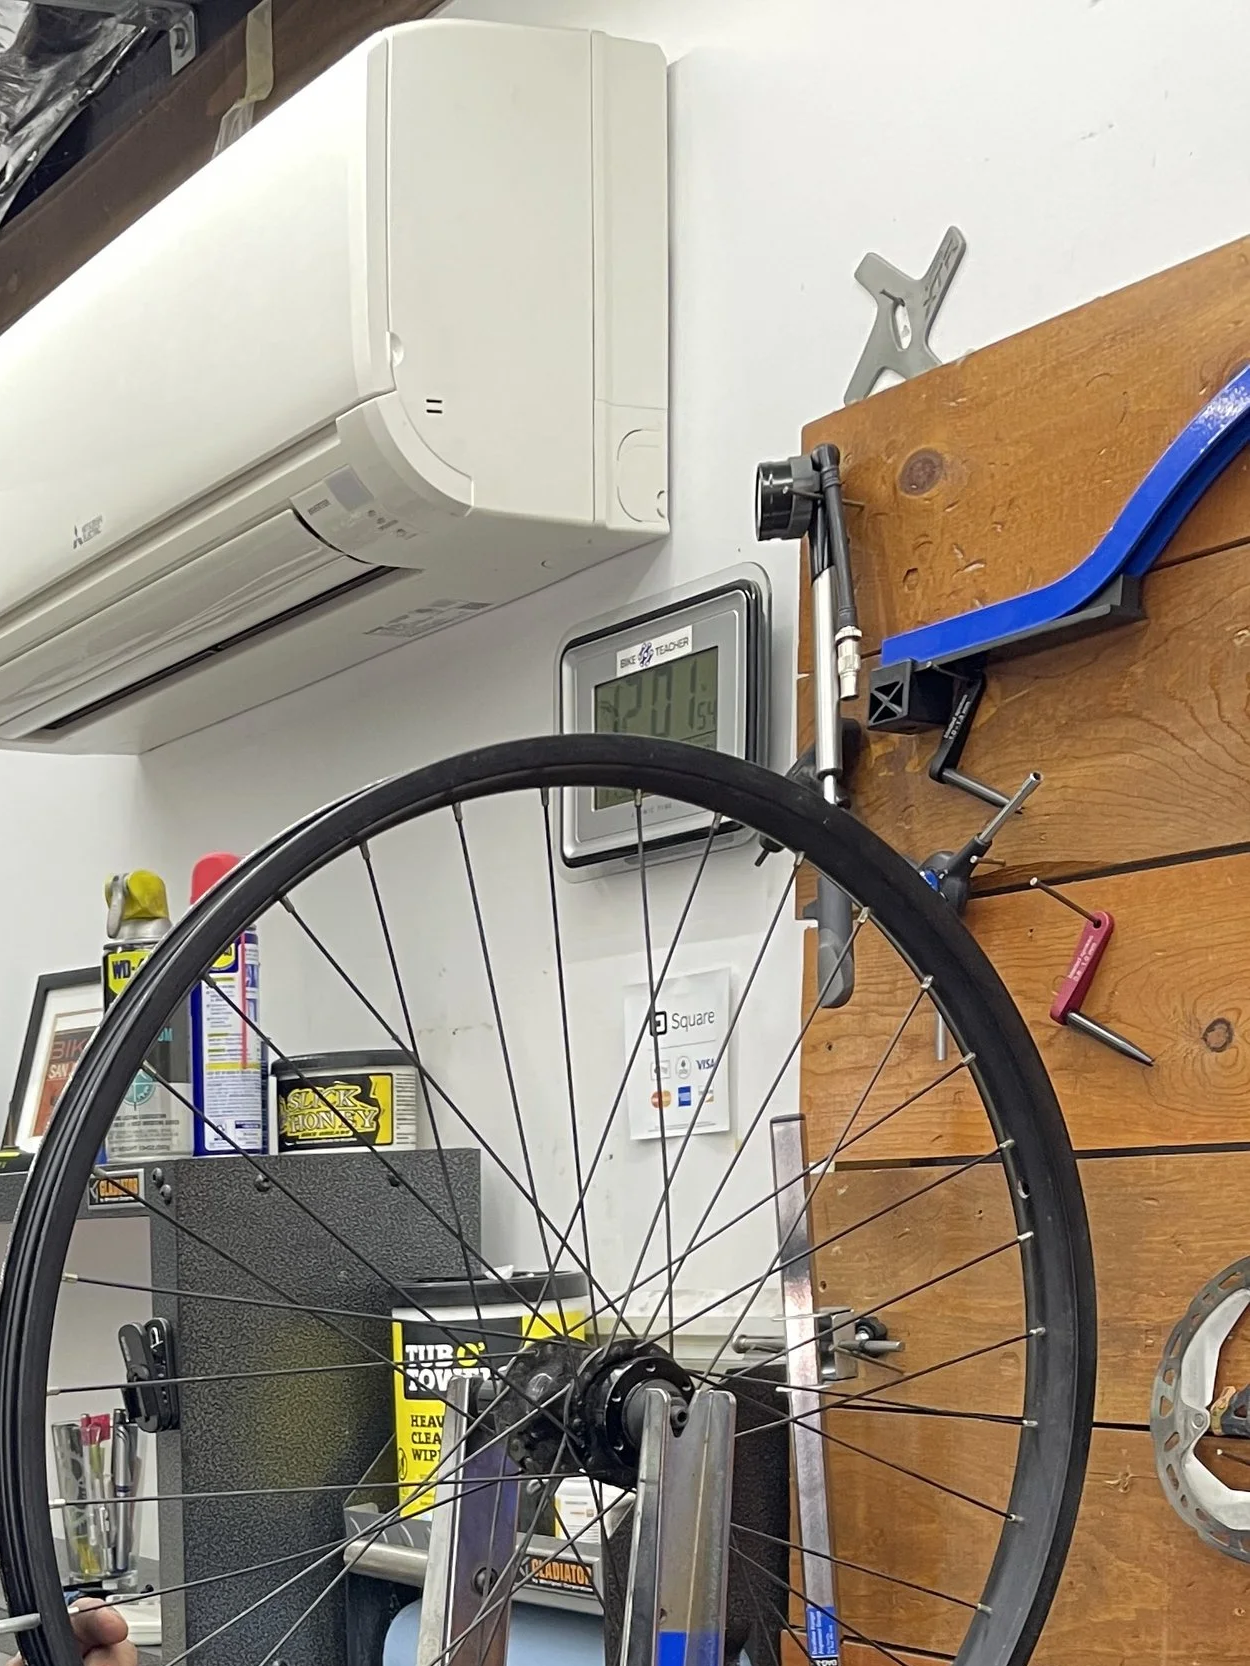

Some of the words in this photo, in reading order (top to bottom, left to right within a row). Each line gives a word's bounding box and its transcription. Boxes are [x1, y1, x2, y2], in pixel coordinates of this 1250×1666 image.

[620, 655, 637, 669] BIKE
[655, 637, 689, 657] TEACHER
[671, 1011, 715, 1032] Square
[51, 1038, 88, 1060] BIK
[696, 1058, 716, 1070] VISA
[288, 1088, 357, 1111] SLICK
[290, 1109, 377, 1133] HONEY
[405, 1344, 454, 1367] TUB
[411, 1414, 444, 1428] HEAV
[411, 1432, 441, 1444] CLEA
[412, 1448, 439, 1461] WIP
